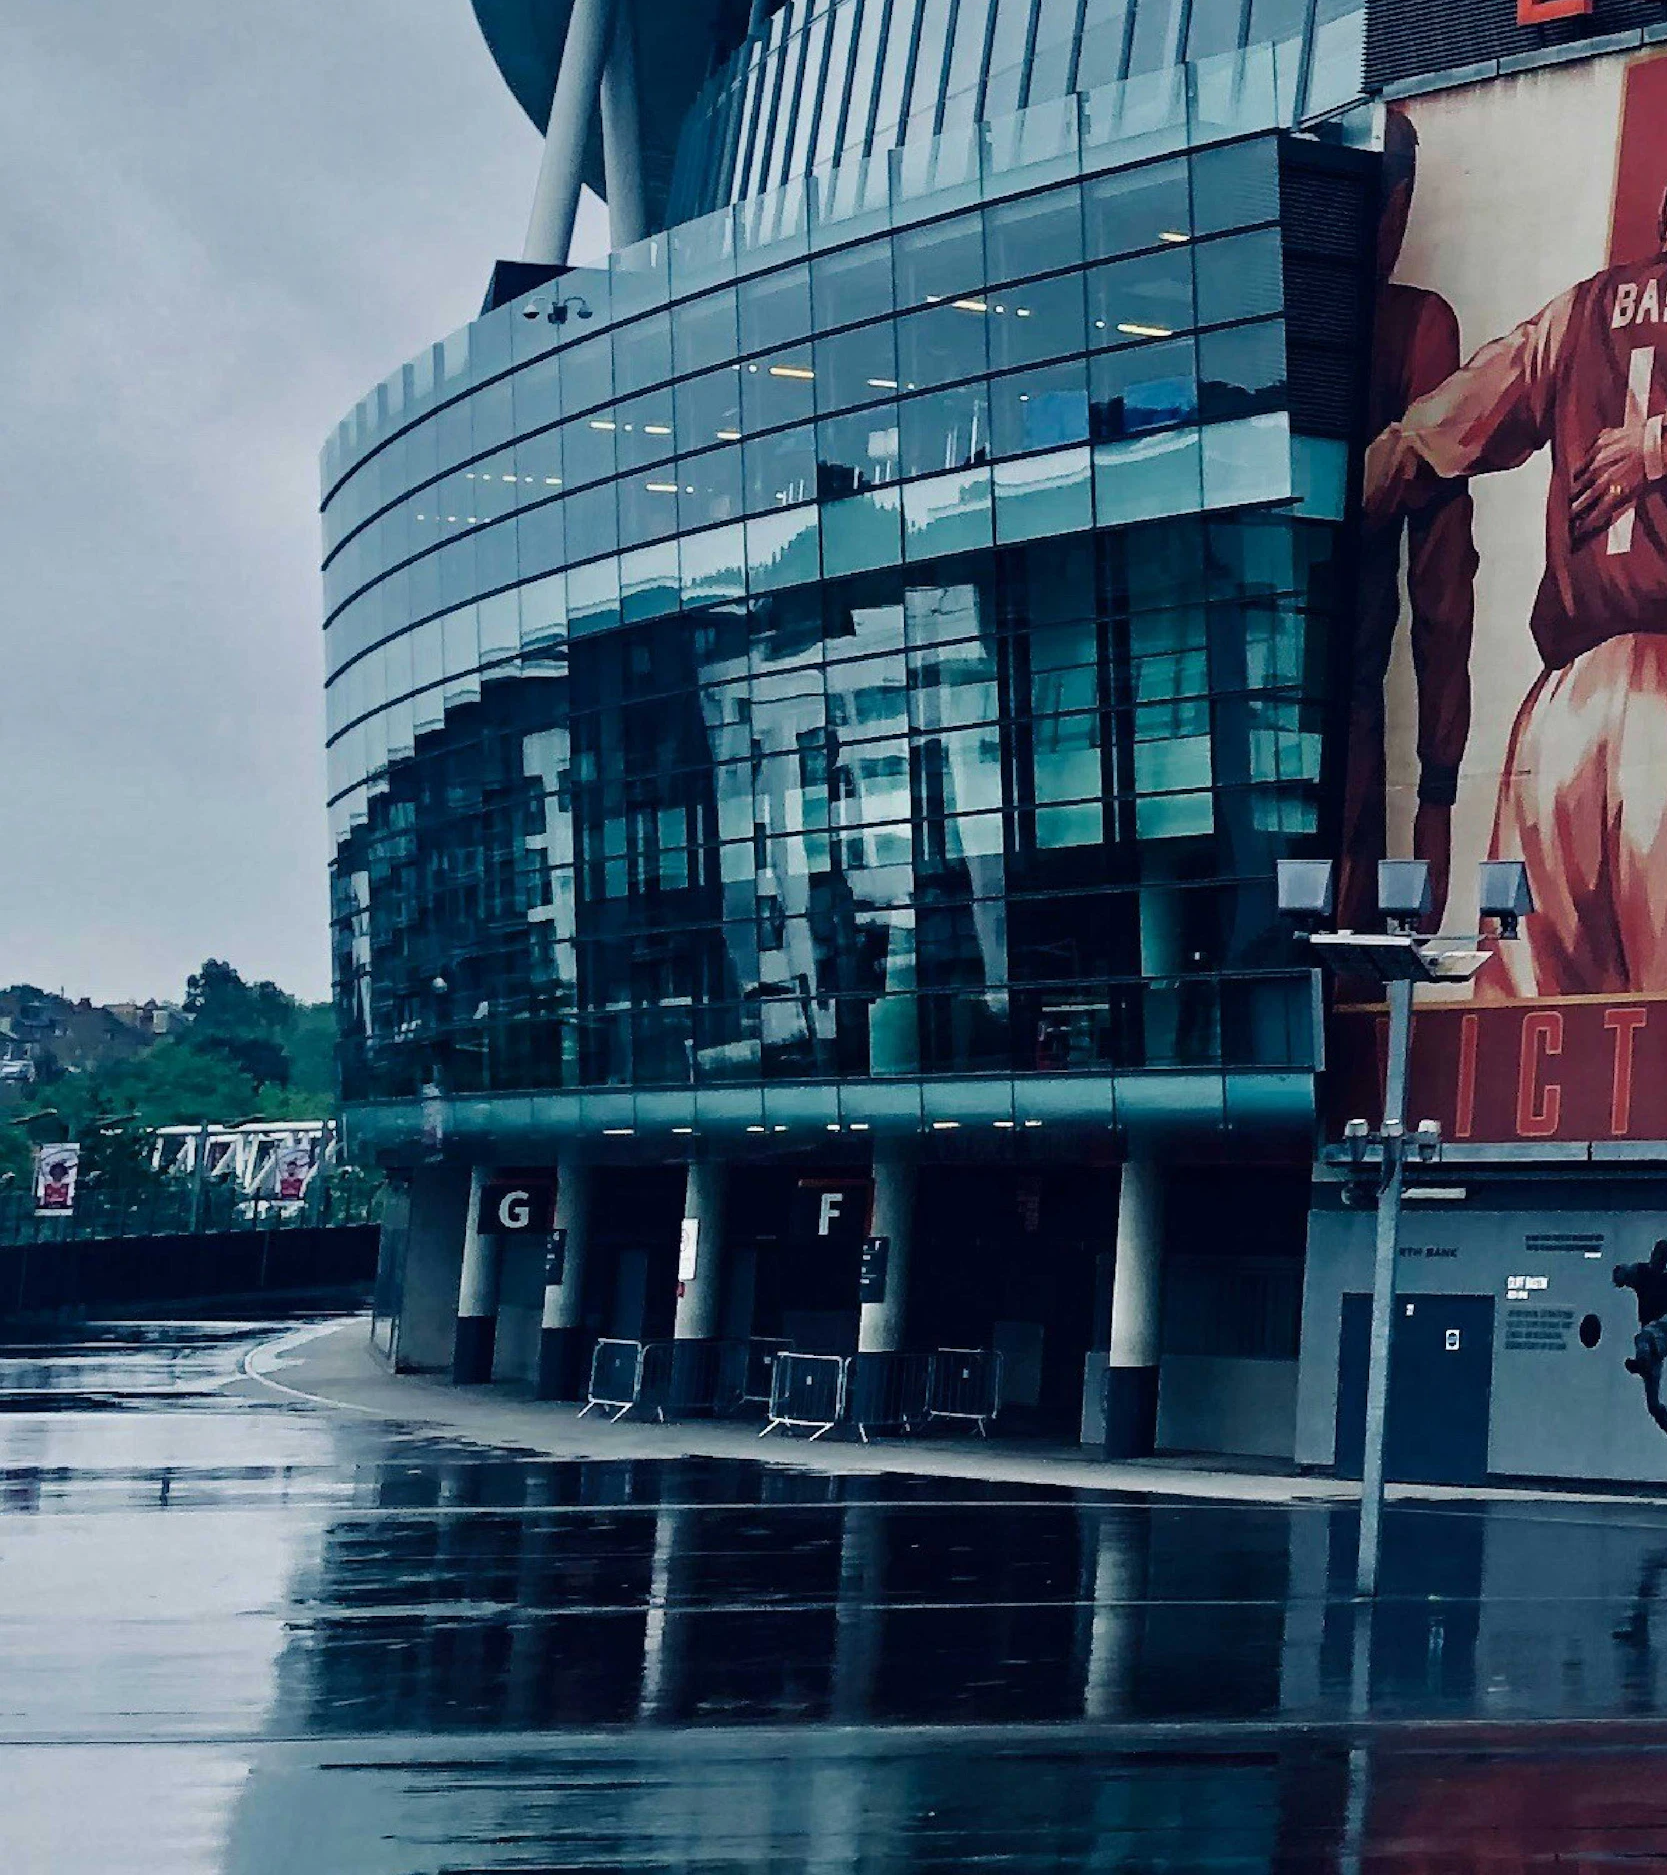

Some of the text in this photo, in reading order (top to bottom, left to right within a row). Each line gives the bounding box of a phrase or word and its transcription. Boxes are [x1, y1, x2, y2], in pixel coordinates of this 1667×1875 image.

[499, 1190, 531, 1229] G
[818, 1193, 843, 1235] F
[1425, 1247, 1457, 1257] BANK
